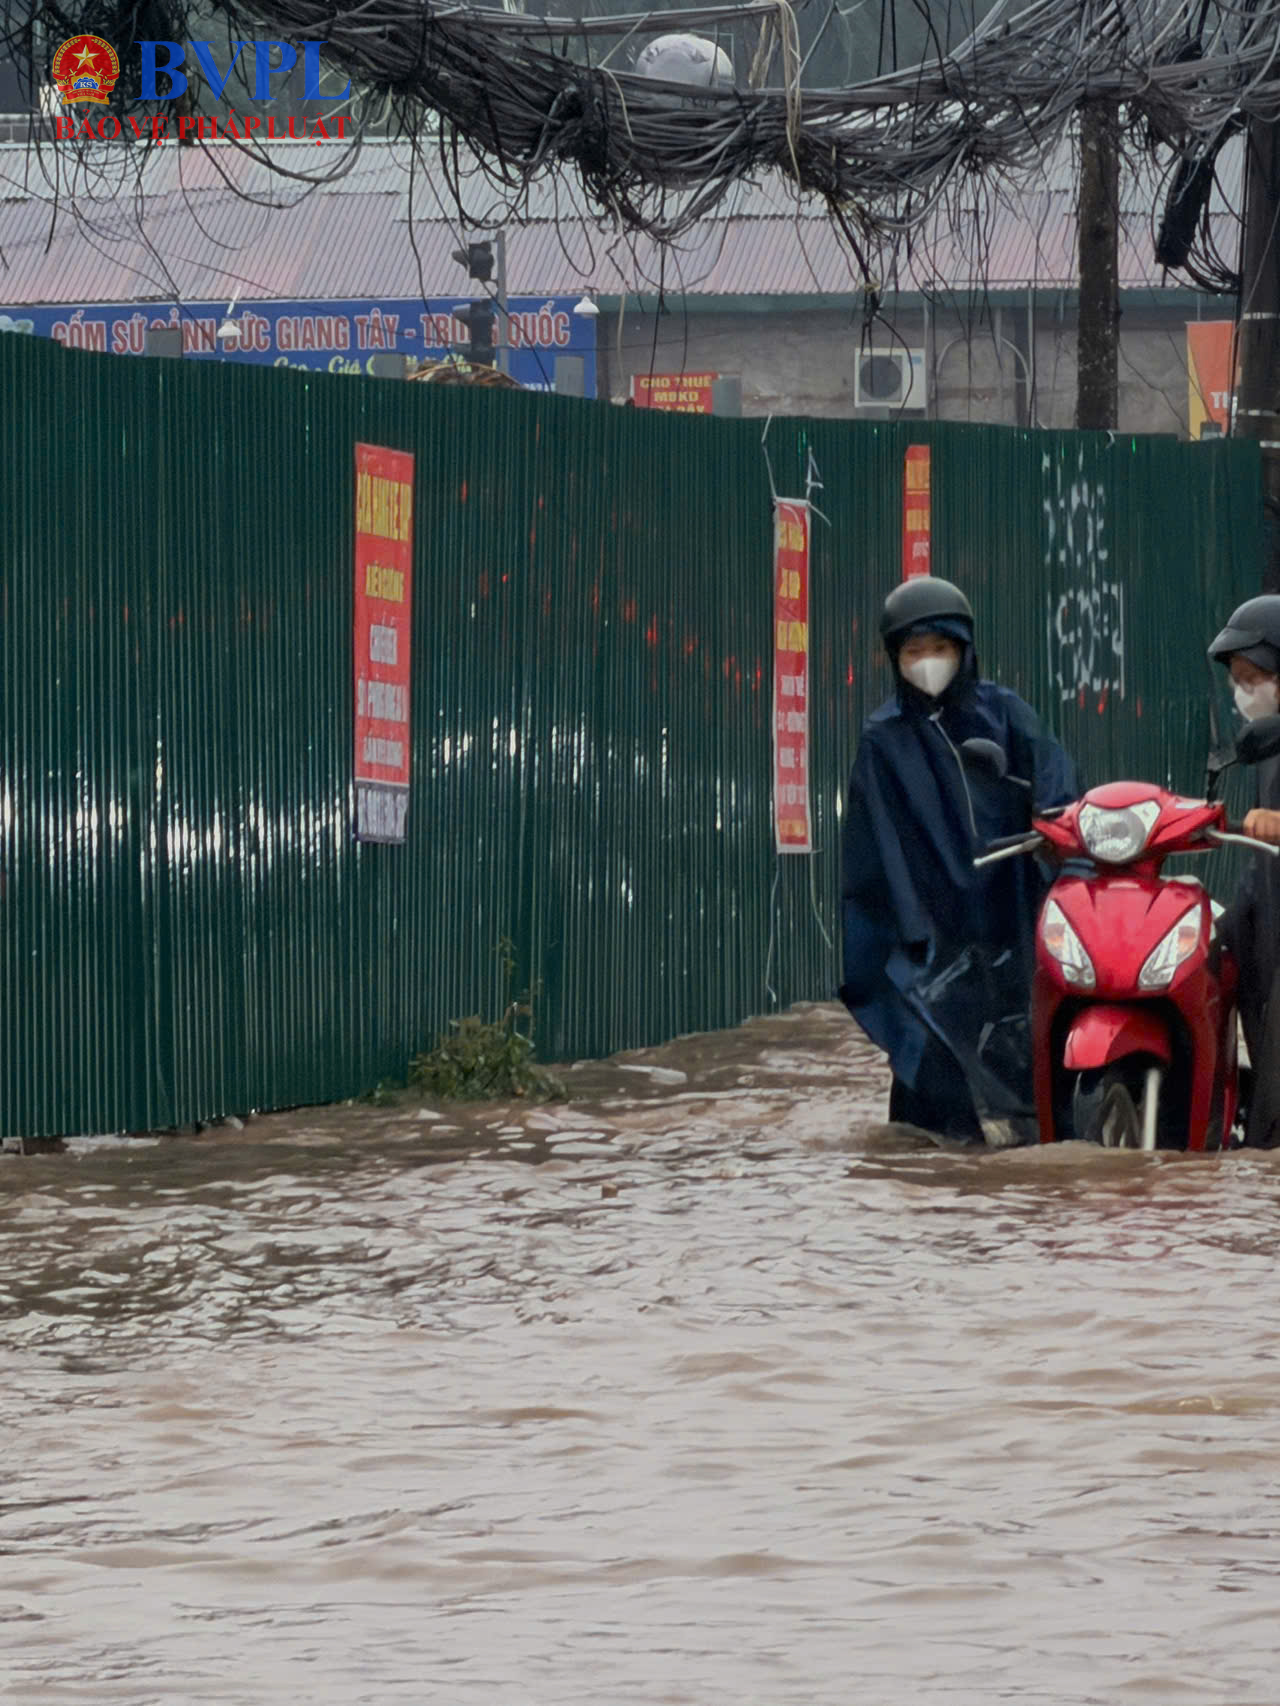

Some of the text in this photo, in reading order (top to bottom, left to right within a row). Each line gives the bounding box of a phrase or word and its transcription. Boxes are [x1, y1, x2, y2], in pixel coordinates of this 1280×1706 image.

[112, 312, 147, 355] SỨ
[276, 315, 349, 351] GIANG
[355, 307, 399, 349] TÂY
[507, 300, 570, 348] QUỐC
